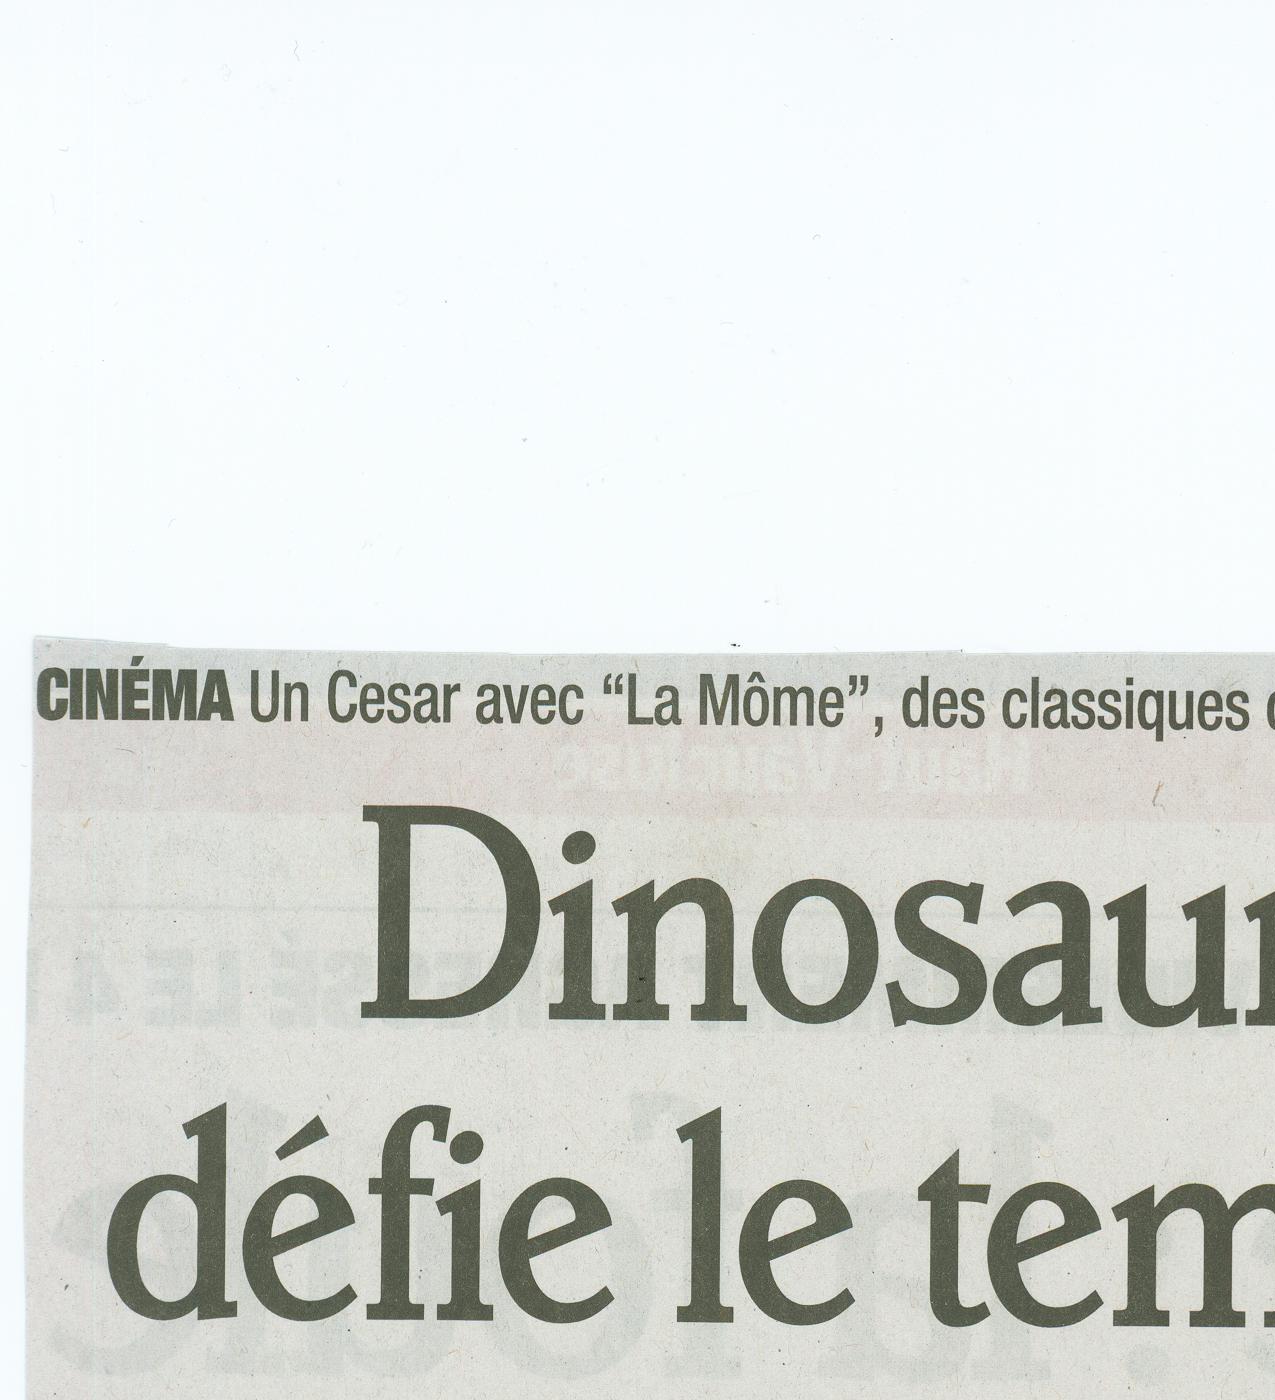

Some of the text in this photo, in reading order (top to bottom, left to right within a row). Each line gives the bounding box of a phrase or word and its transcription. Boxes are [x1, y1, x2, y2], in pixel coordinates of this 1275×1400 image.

[36, 655, 235, 722] CINÉMA
[250, 669, 309, 723] Un
[327, 669, 461, 724] Cesar
[475, 683, 584, 726] avec
[699, 671, 883, 738] Môme”,
[902, 675, 985, 729] des
[1002, 676, 1250, 742] classiques
[106, 1102, 615, 1324] défie
[676, 1107, 856, 1326] le
